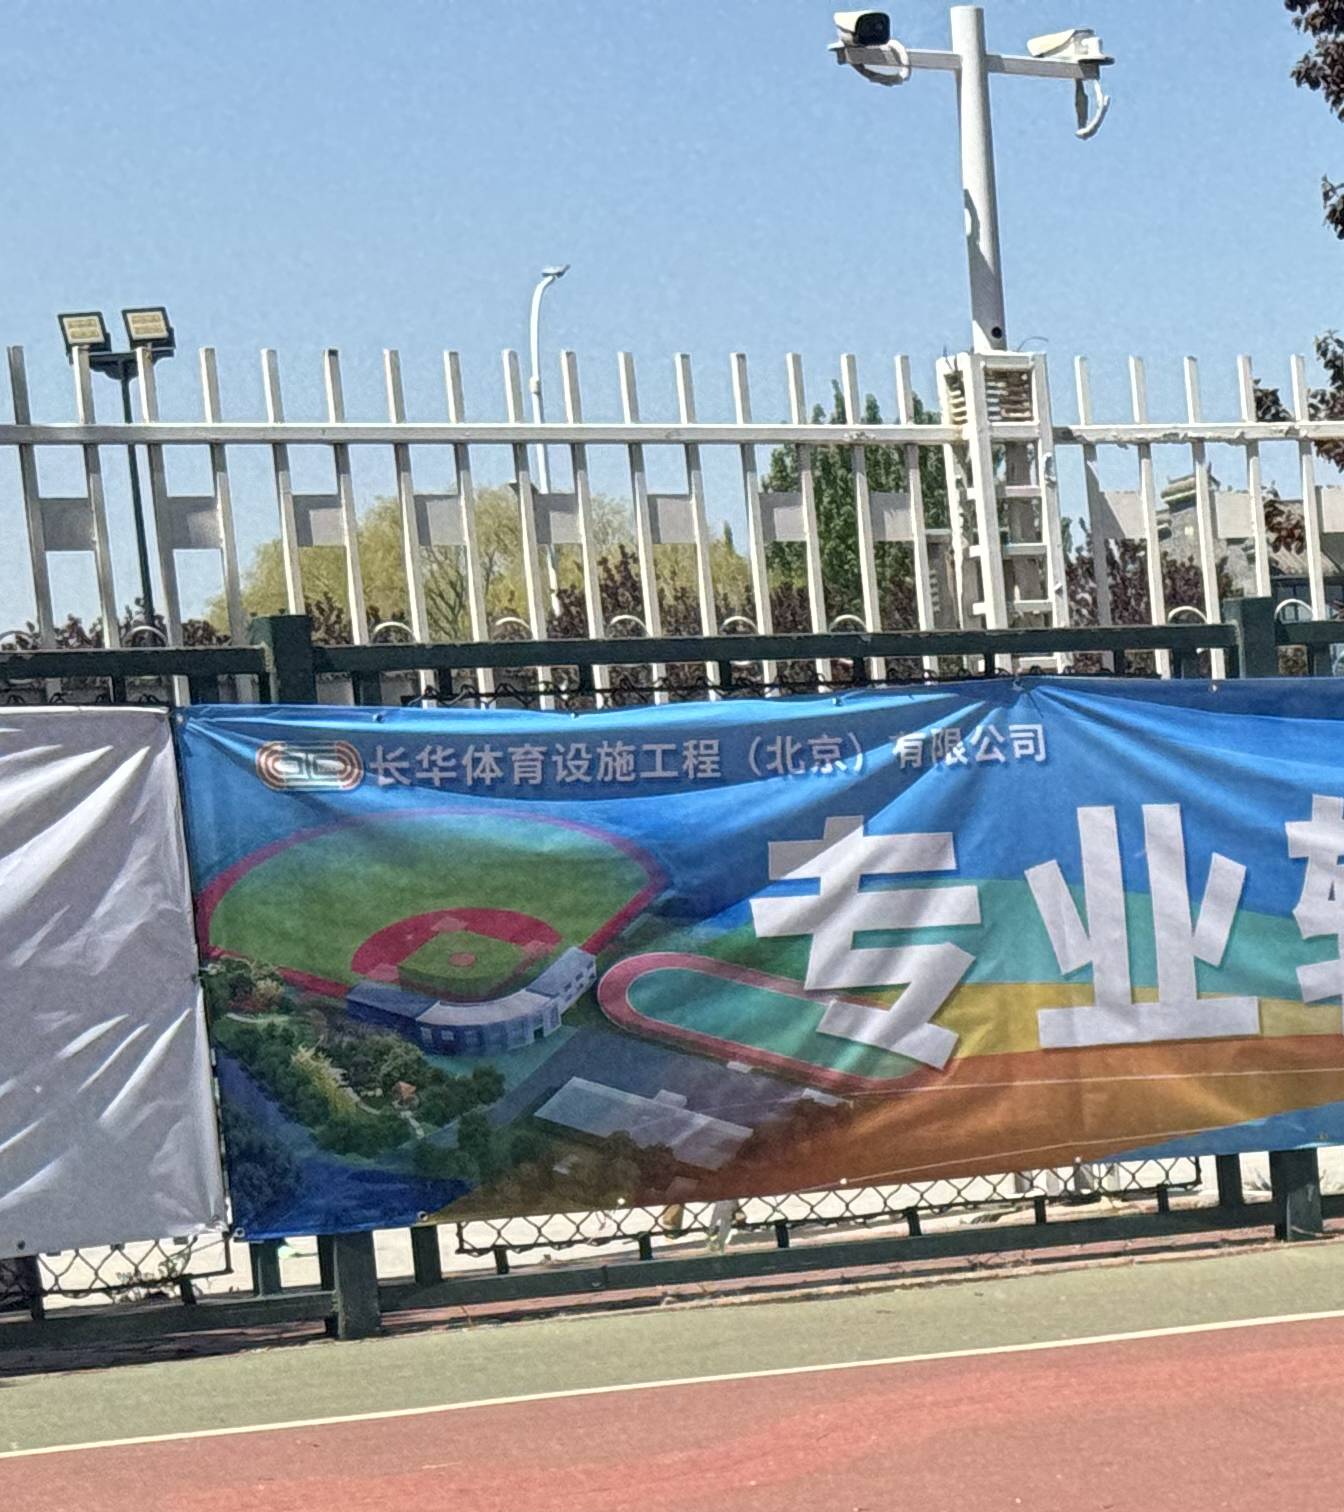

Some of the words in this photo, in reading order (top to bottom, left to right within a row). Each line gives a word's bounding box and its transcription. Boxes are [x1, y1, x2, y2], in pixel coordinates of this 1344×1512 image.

[369, 723, 1047, 787] 长华体育设施工程（北京）有限公司
